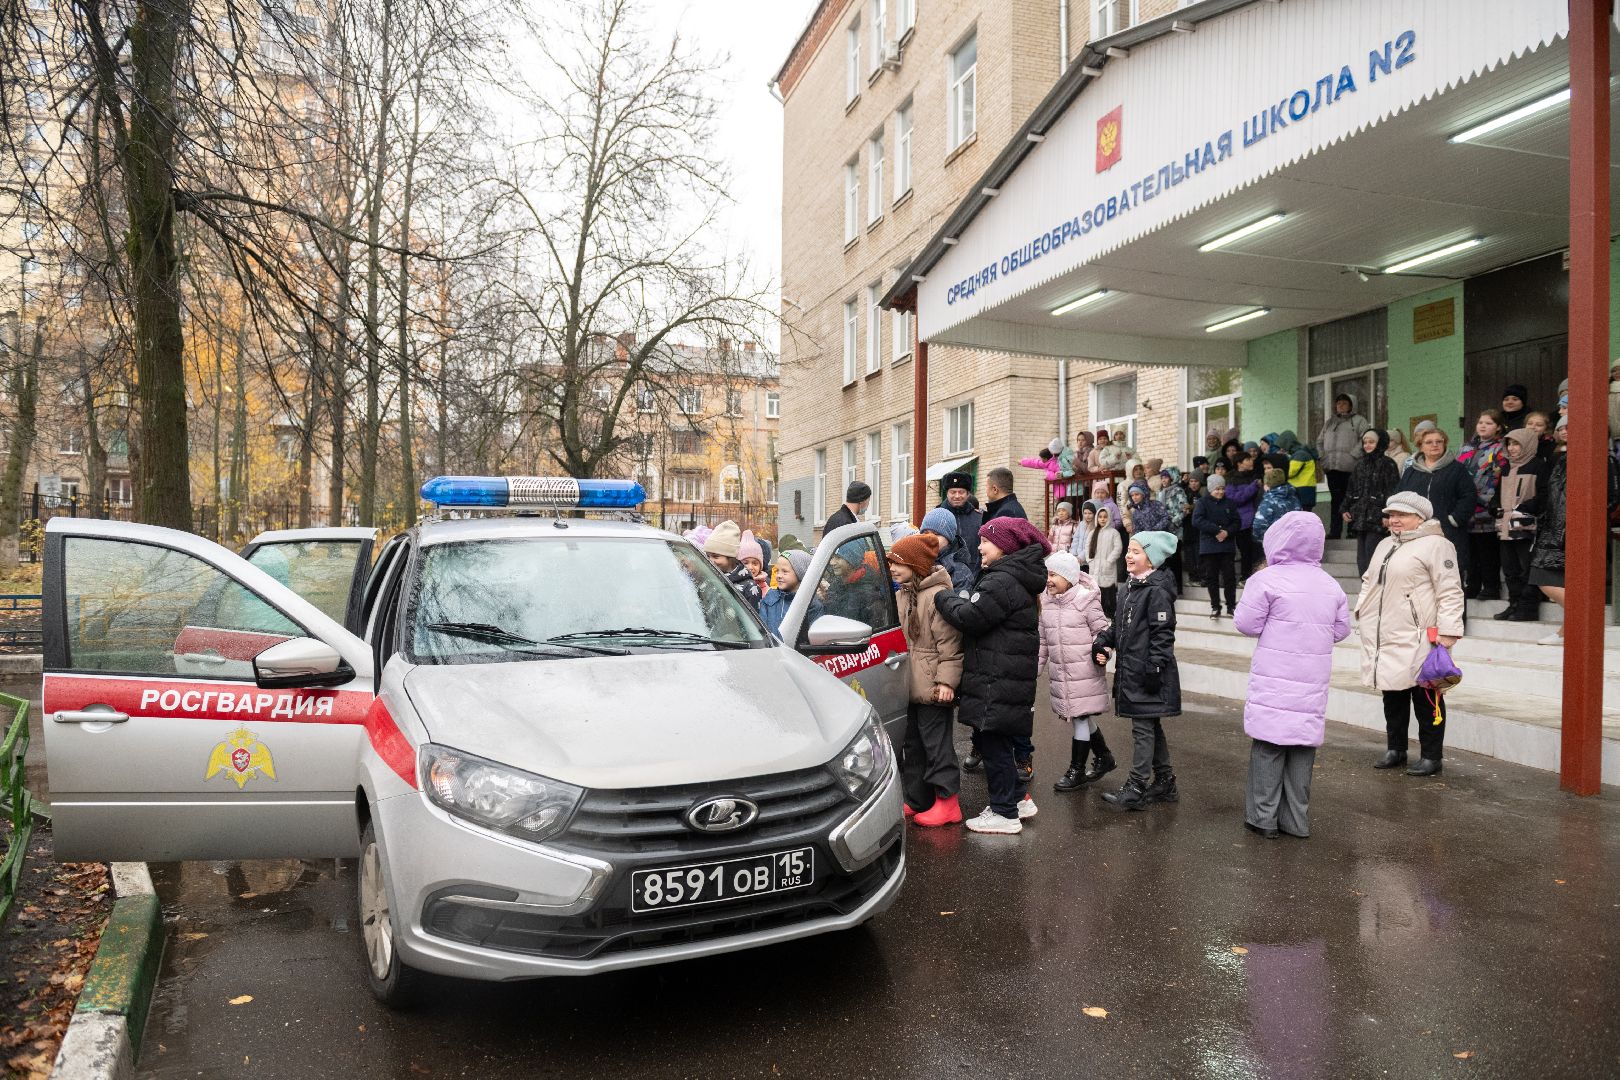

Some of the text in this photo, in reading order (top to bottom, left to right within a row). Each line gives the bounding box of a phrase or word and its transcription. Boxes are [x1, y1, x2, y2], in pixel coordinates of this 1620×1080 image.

[947, 261, 998, 306] СРЕДНЯЯ
[1001, 129, 1233, 276] ОБЩЕОБРАЗОВАТЕЛЬНАЯ
[1243, 64, 1357, 149] ШКОЛА
[818, 643, 881, 674] СГВАРДИЯ
[139, 689, 334, 719] РОСГВАРДИЯ
[778, 851, 805, 878] 15
[643, 865, 770, 906] 8591 ОВ
[781, 875, 801, 887] RUS
